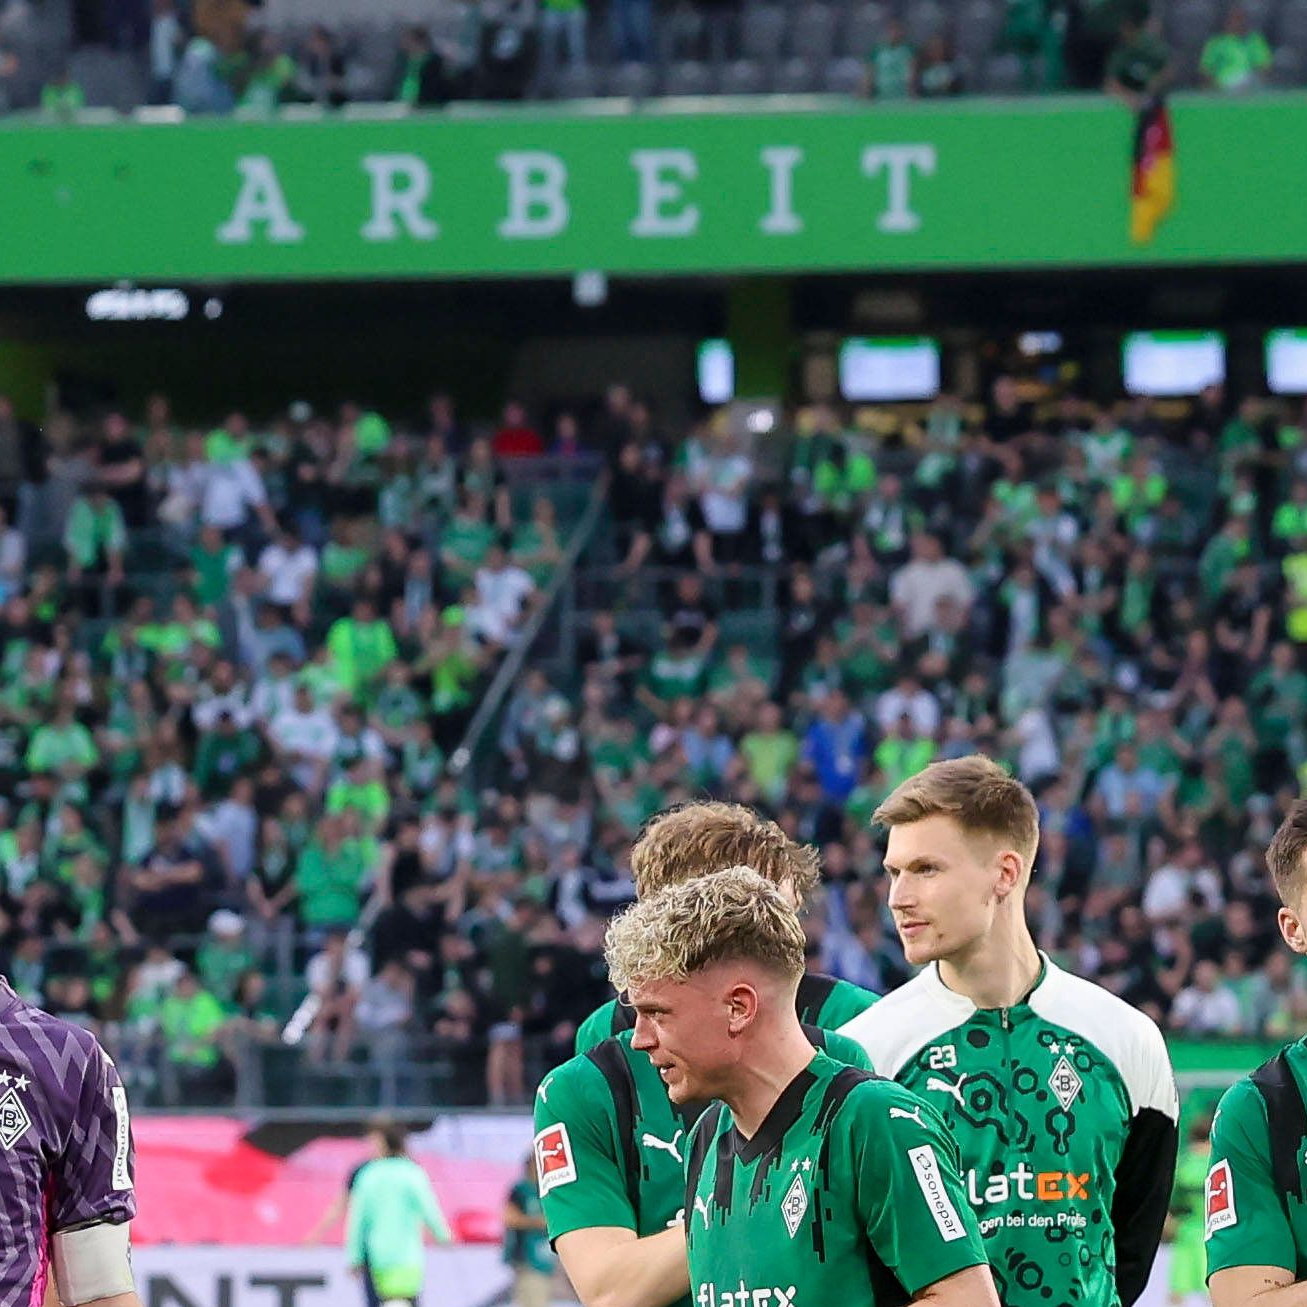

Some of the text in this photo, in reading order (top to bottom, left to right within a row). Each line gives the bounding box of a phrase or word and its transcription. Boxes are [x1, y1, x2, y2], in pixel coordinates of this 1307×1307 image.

[215, 144, 937, 243] ARBEIT
[929, 1045, 957, 1070] 23
[923, 1172, 959, 1236] sonepar
[1006, 1213, 1025, 1227] bei
[1028, 1213, 1054, 1228] den
[1057, 1212, 1088, 1228] Profis
